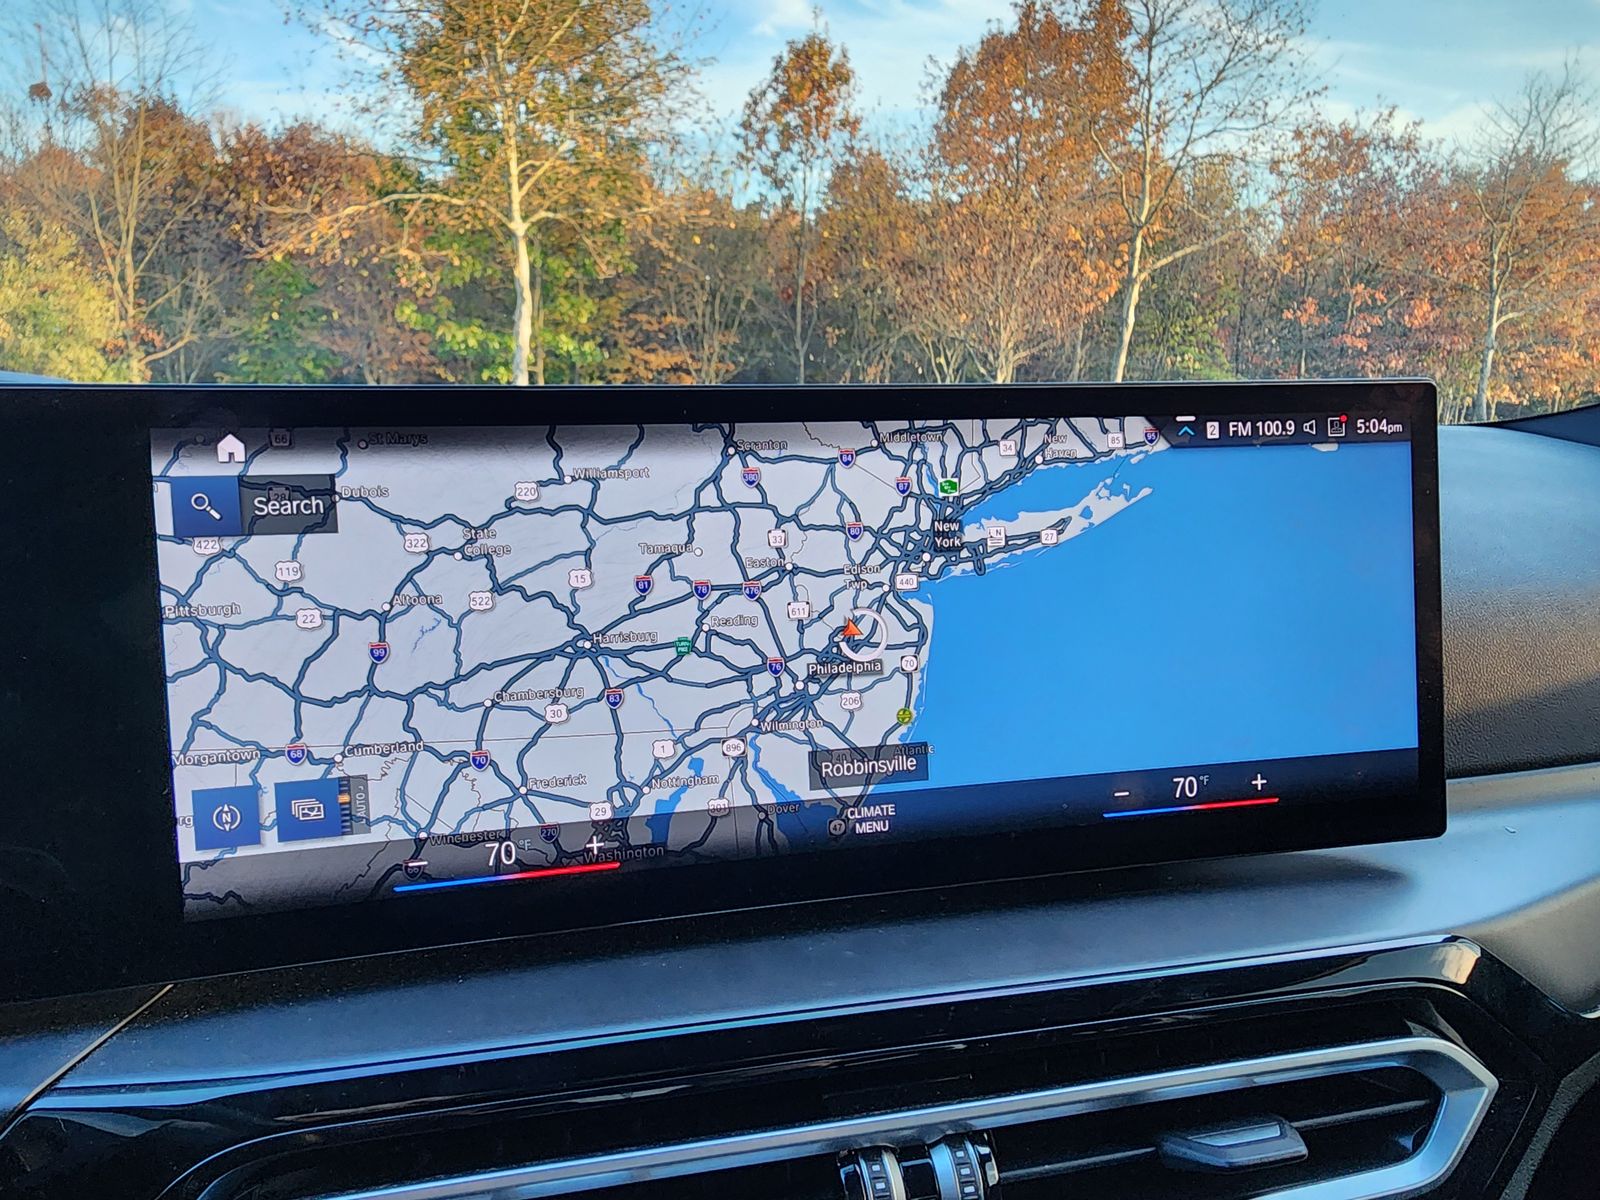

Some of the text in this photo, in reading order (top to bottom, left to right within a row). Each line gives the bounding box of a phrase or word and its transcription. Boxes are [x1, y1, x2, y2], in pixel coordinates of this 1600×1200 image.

[1229, 422, 1252, 436] FM
[1256, 421, 1295, 436] 100.9
[1356, 419, 1402, 434] 5:04pm
[388, 432, 428, 446] Marys
[880, 432, 942, 443] Middletown
[1044, 434, 1066, 444] New
[1111, 436, 1120, 444] 85
[1147, 432, 1156, 440] 95
[737, 440, 787, 451] Scranton
[1003, 444, 1012, 453] 34
[1045, 448, 1077, 458] Haven
[573, 467, 650, 482] Williamsport
[342, 486, 389, 499] Dubois
[518, 487, 536, 497] 220
[254, 496, 324, 516] Search
[850, 527, 860, 536] 80
[934, 521, 959, 532] New
[464, 528, 496, 540] State
[772, 535, 782, 544] 33
[1044, 533, 1054, 542] 27
[196, 540, 218, 550] 422
[407, 538, 426, 548] 322
[935, 537, 962, 548] York
[464, 544, 511, 557] College
[638, 543, 692, 556] Tamaqua
[746, 558, 784, 568] Easton
[278, 566, 298, 576] 119
[844, 564, 880, 574] Edison
[575, 574, 586, 584] 15
[899, 578, 914, 586] 440
[638, 581, 648, 590] 81
[845, 580, 868, 592] Twp
[393, 594, 442, 606] Altoona
[472, 597, 490, 606] 522
[164, 603, 241, 618] Pittsburgh
[791, 607, 806, 616] 611
[302, 614, 316, 624] 22
[711, 615, 758, 628] Reading
[593, 630, 658, 644] Harrisburg
[373, 648, 384, 657] 99
[771, 662, 782, 670] 76
[809, 661, 882, 675] Philadelphia
[904, 659, 914, 668] 70
[494, 686, 584, 702] Chambersburg
[843, 697, 859, 706] 206
[550, 709, 562, 718] 30
[761, 718, 824, 732] Wilmington
[345, 742, 424, 757] Cumberland
[726, 743, 742, 752] 896
[174, 750, 261, 766] Morgantown
[290, 750, 302, 758] 68
[476, 756, 486, 765] 70
[822, 756, 917, 778] Robbinsville
[529, 774, 586, 789] Frederick
[652, 774, 719, 790] Nottingham
[1173, 777, 1198, 798] 70
[595, 807, 606, 816] 29
[767, 804, 800, 816] Dover
[848, 804, 896, 819] CLIMATE
[832, 822, 843, 832] 47
[856, 820, 889, 834] MENU
[542, 828, 557, 838] 270
[430, 832, 500, 846] Winchester
[485, 841, 516, 866] 70
[584, 846, 664, 863] Washington
